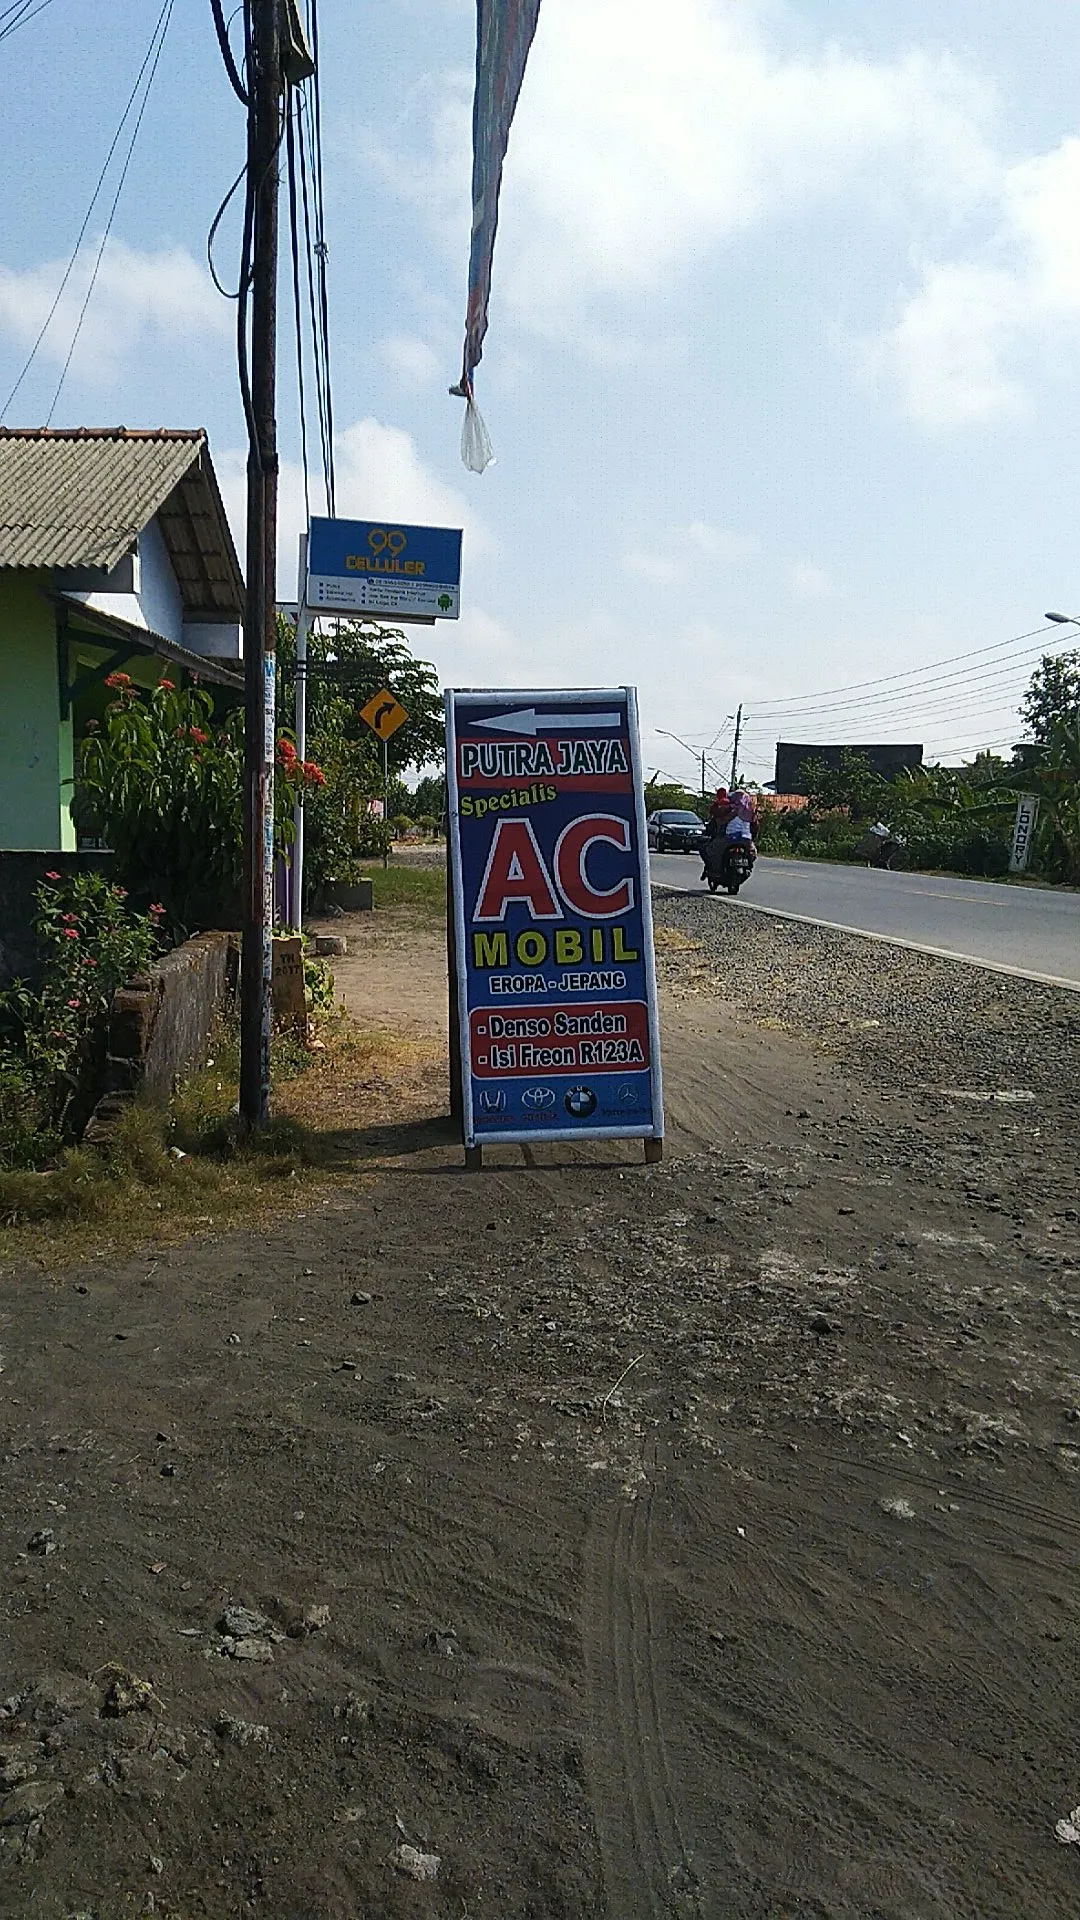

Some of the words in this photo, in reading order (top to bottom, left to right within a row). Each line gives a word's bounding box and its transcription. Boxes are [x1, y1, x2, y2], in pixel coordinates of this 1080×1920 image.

[345, 555, 425, 575] CELLULER
[461, 742, 555, 777] PUTRA
[557, 739, 629, 775] JAYA
[459, 783, 558, 818] Specialis
[472, 813, 635, 922] AC
[473, 928, 637, 967] MOBIL
[490, 974, 547, 994] EROPA
[558, 971, 626, 992] JEPANG
[489, 1015, 550, 1038] Denso
[554, 1011, 626, 1036] Sanden
[490, 1045, 516, 1069] Isi
[519, 1043, 575, 1067] Freon
[579, 1039, 644, 1065] R123A
